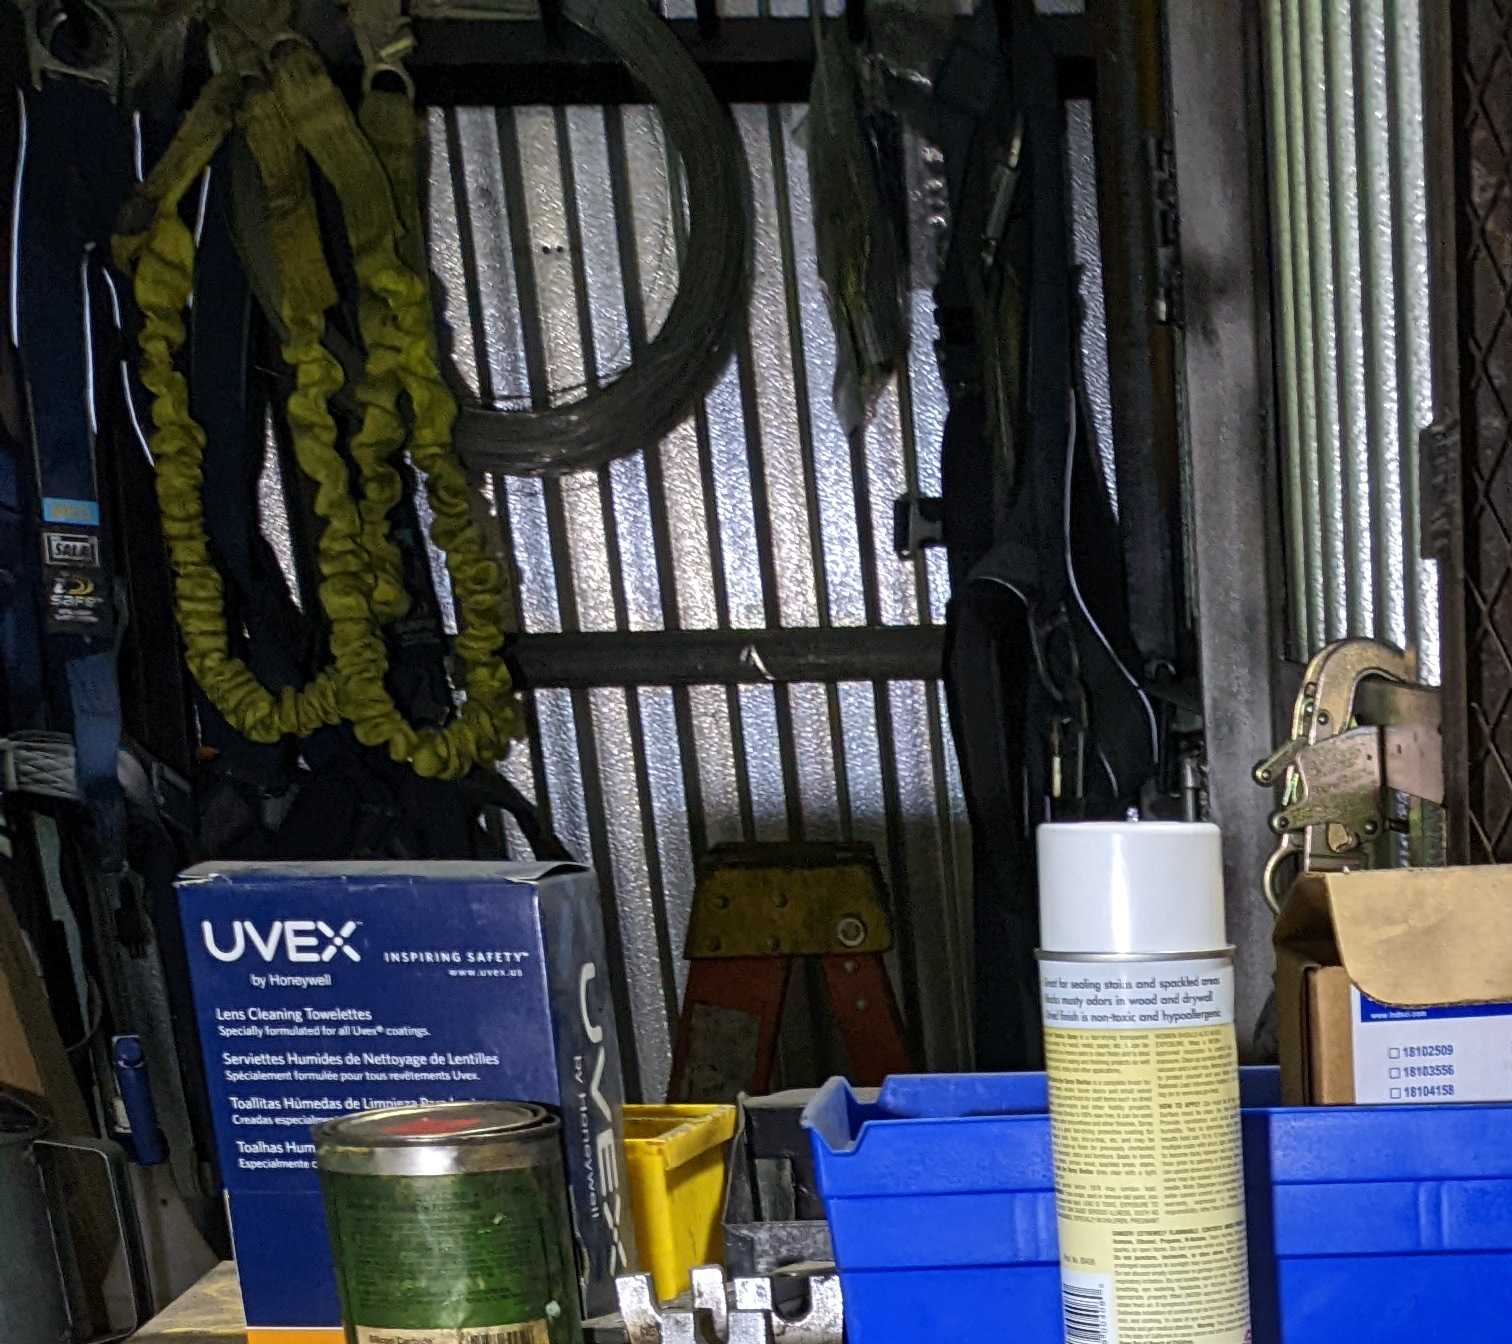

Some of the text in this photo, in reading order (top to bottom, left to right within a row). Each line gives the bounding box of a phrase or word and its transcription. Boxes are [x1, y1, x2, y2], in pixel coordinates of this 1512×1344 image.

[202, 920, 361, 962] UVEX
[383, 952, 462, 963] INSPIRING
[252, 974, 332, 989] by Honeywell
[1136, 978, 1156, 989] and
[1086, 996, 1113, 1006] odors
[1115, 995, 1126, 1006] in
[1129, 995, 1157, 1006] wood
[1160, 993, 1180, 1005] and
[215, 1008, 373, 1023] Lens Cleaning Towelettes
[1081, 1011, 1089, 1022] is
[1091, 1011, 1136, 1023] non-toxic
[1139, 1011, 1160, 1022] and
[217, 1025, 263, 1038] Specially
[265, 1026, 320, 1036] formulated
[322, 1026, 337, 1036] for
[338, 1026, 351, 1036] all
[386, 1027, 432, 1038] coatings.
[1402, 1045, 1454, 1058] 18102509
[222, 1052, 500, 1067] Serviettes Humides de Nettoyage de Lentilles
[341, 1073, 364, 1083] pour
[365, 1072, 388, 1081] tous
[452, 1071, 481, 1081] Uvex.
[229, 1097, 281, 1109] Toallitas
[344, 1098, 361, 1109] de
[231, 1114, 273, 1125] Creadas
[579, 962, 628, 1277] UVEX
[236, 1141, 283, 1153] Toalhas
